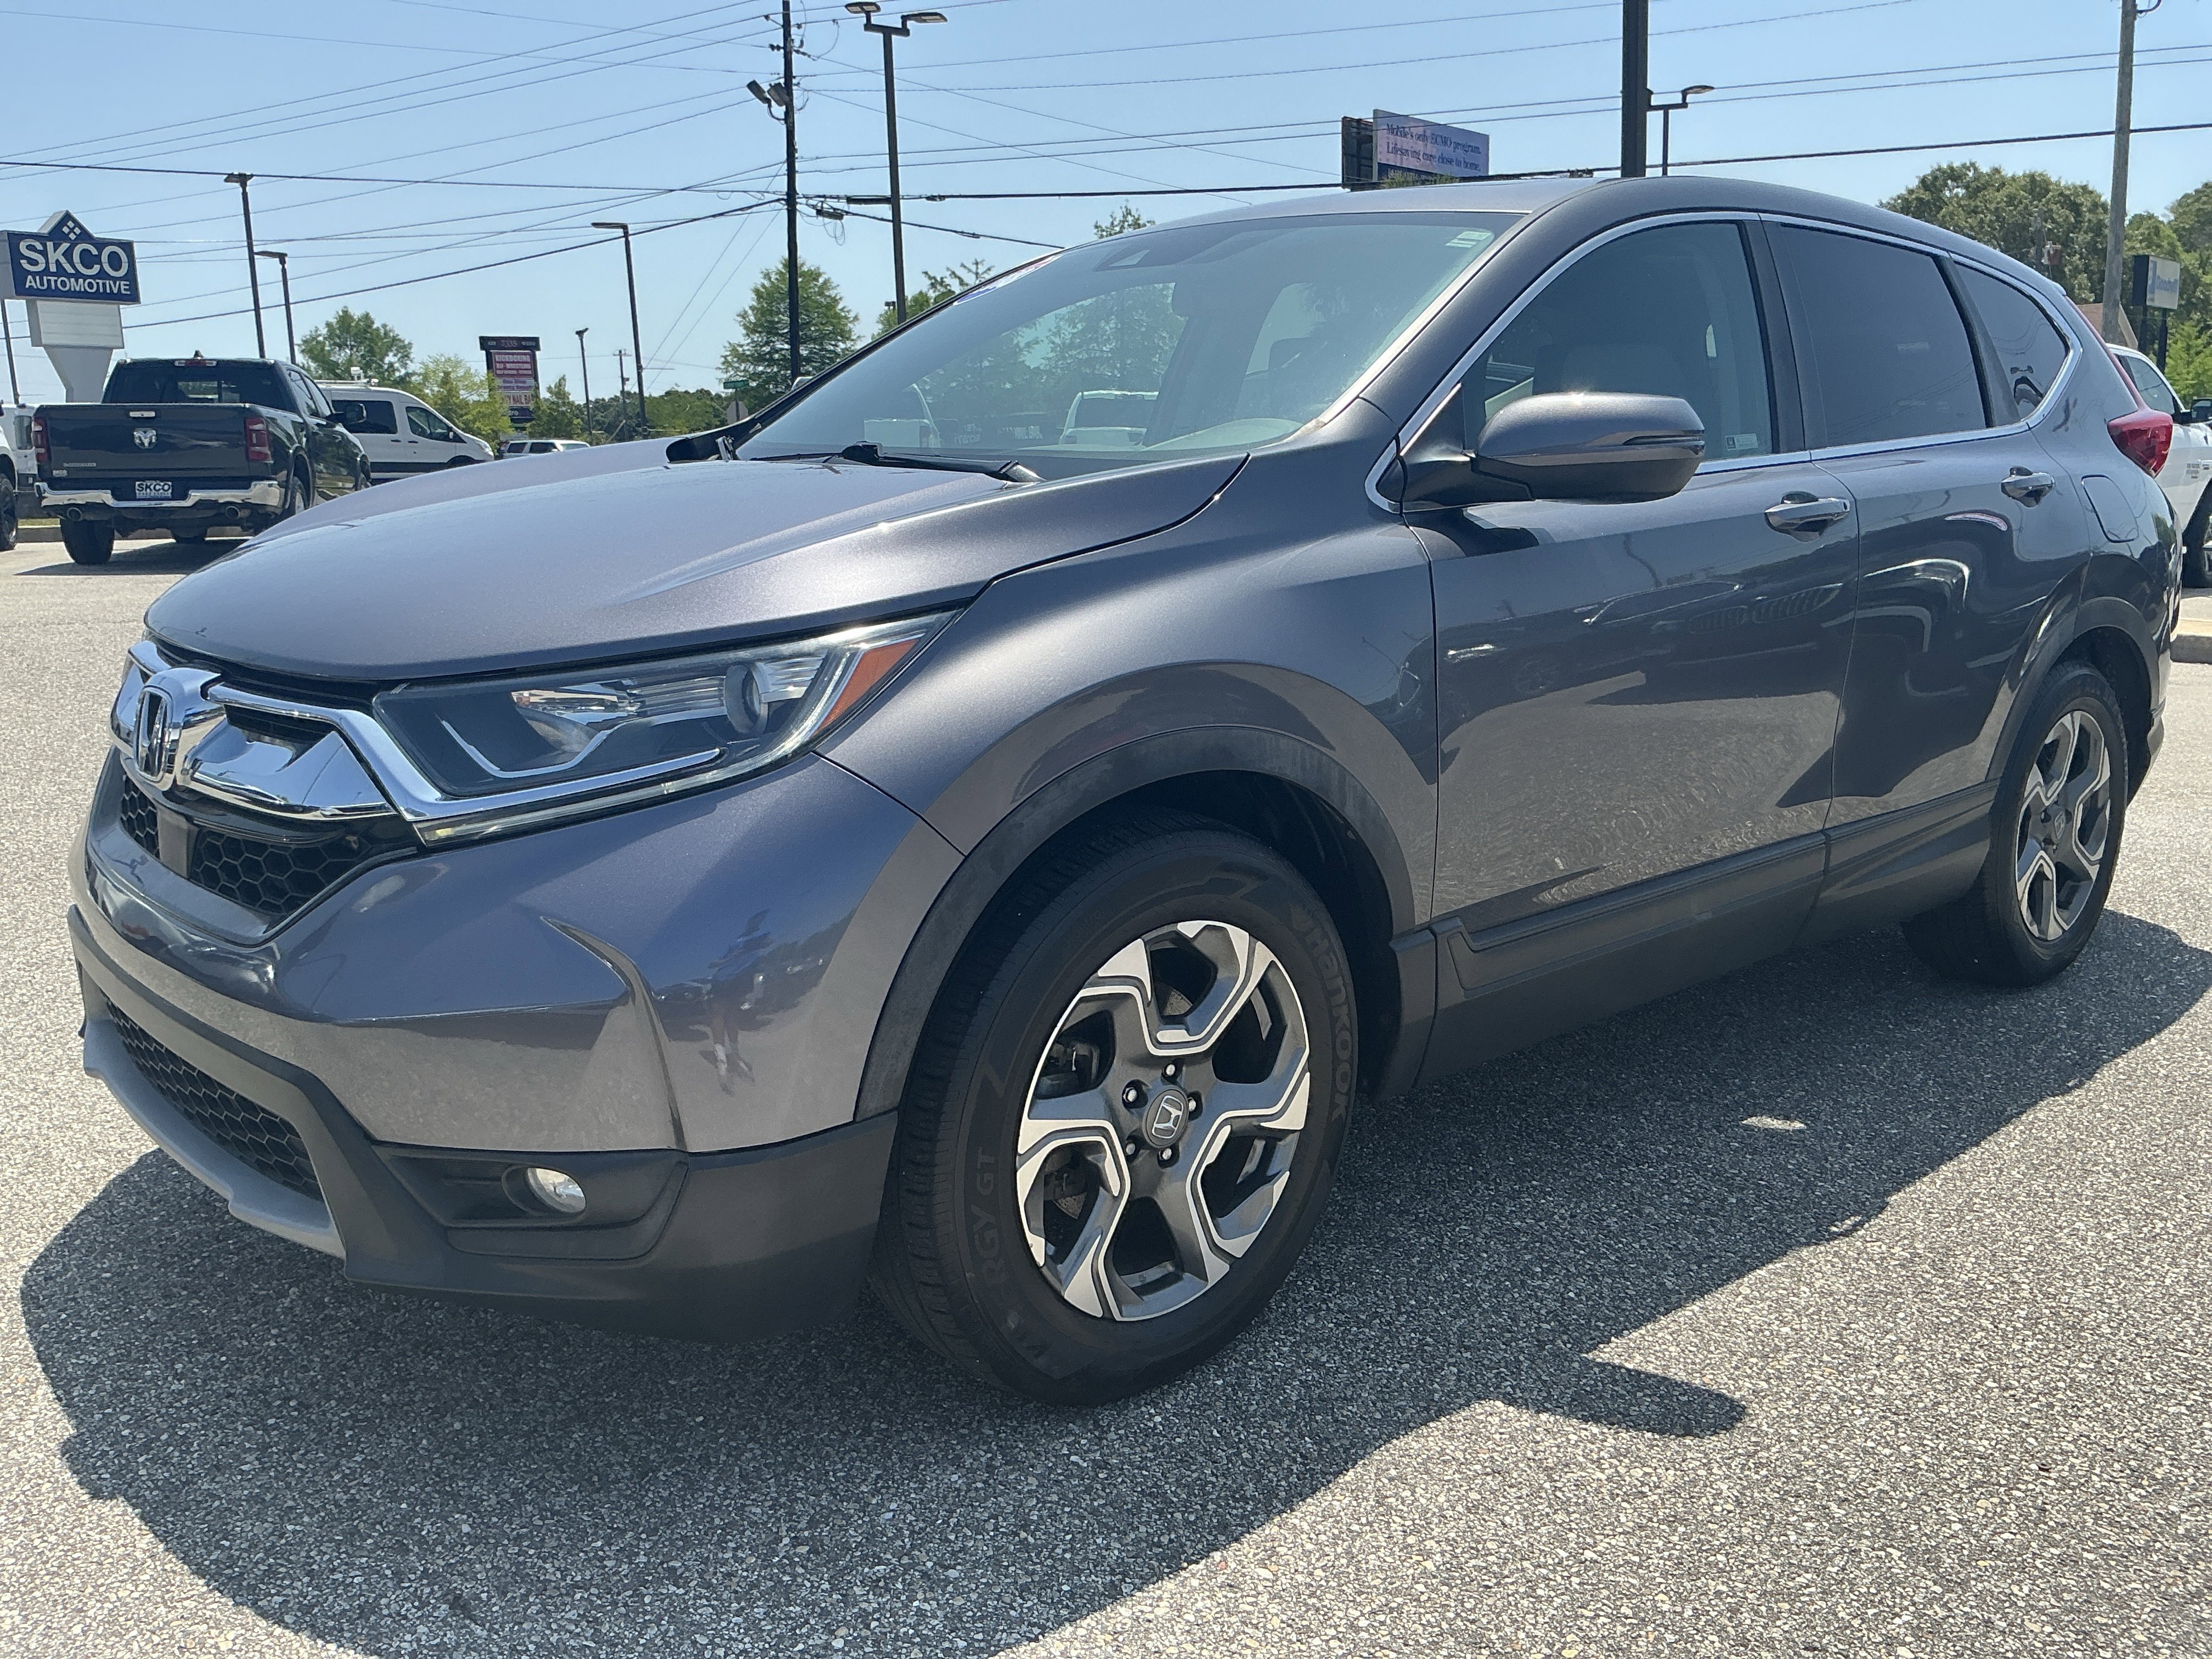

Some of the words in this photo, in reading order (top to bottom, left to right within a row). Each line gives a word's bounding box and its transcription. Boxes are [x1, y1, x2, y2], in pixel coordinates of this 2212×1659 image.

[1386, 123, 1414, 139] Mobile's
[1415, 128, 1427, 146] only
[1431, 133, 1452, 148] ECMO
[1453, 141, 1481, 154] program.
[1386, 142, 1421, 163] Lifesaving
[1422, 152, 1437, 163] care
[1437, 152, 1454, 165] close
[1455, 158, 1462, 167] to
[1463, 157, 1481, 172] home.
[18, 239, 129, 277] SKCO
[25, 275, 131, 295] AUTOMOTIVE
[137, 483, 171, 492] SKCO
[975, 1147, 996, 1196] GT
